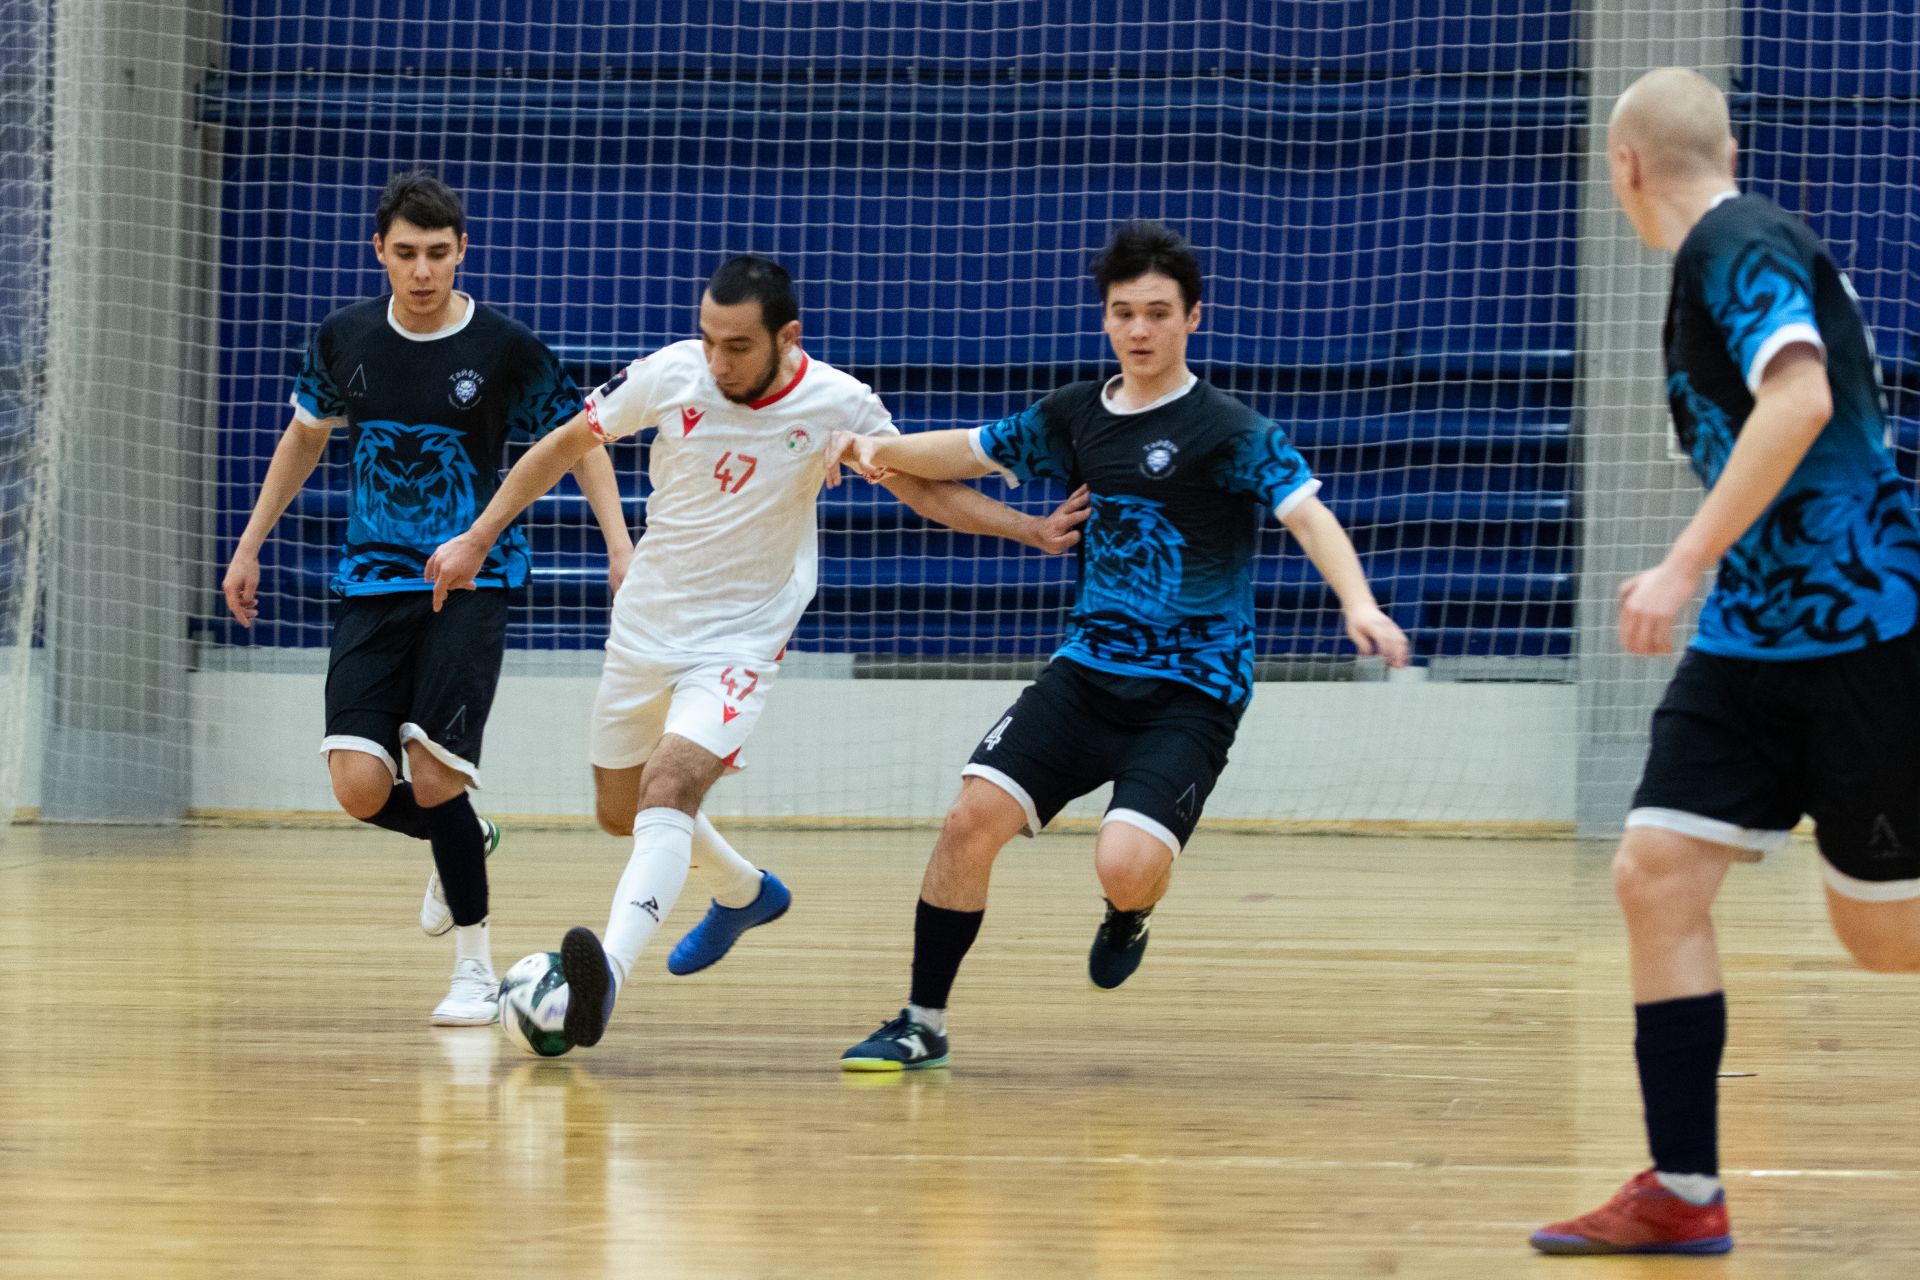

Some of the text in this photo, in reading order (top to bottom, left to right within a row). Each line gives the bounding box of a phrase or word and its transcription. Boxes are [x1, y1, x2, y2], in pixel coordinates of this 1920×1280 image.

[449, 368, 484, 384] Тайфун
[714, 451, 757, 494] 47
[720, 666, 758, 701] 47
[984, 716, 1013, 750] 4
